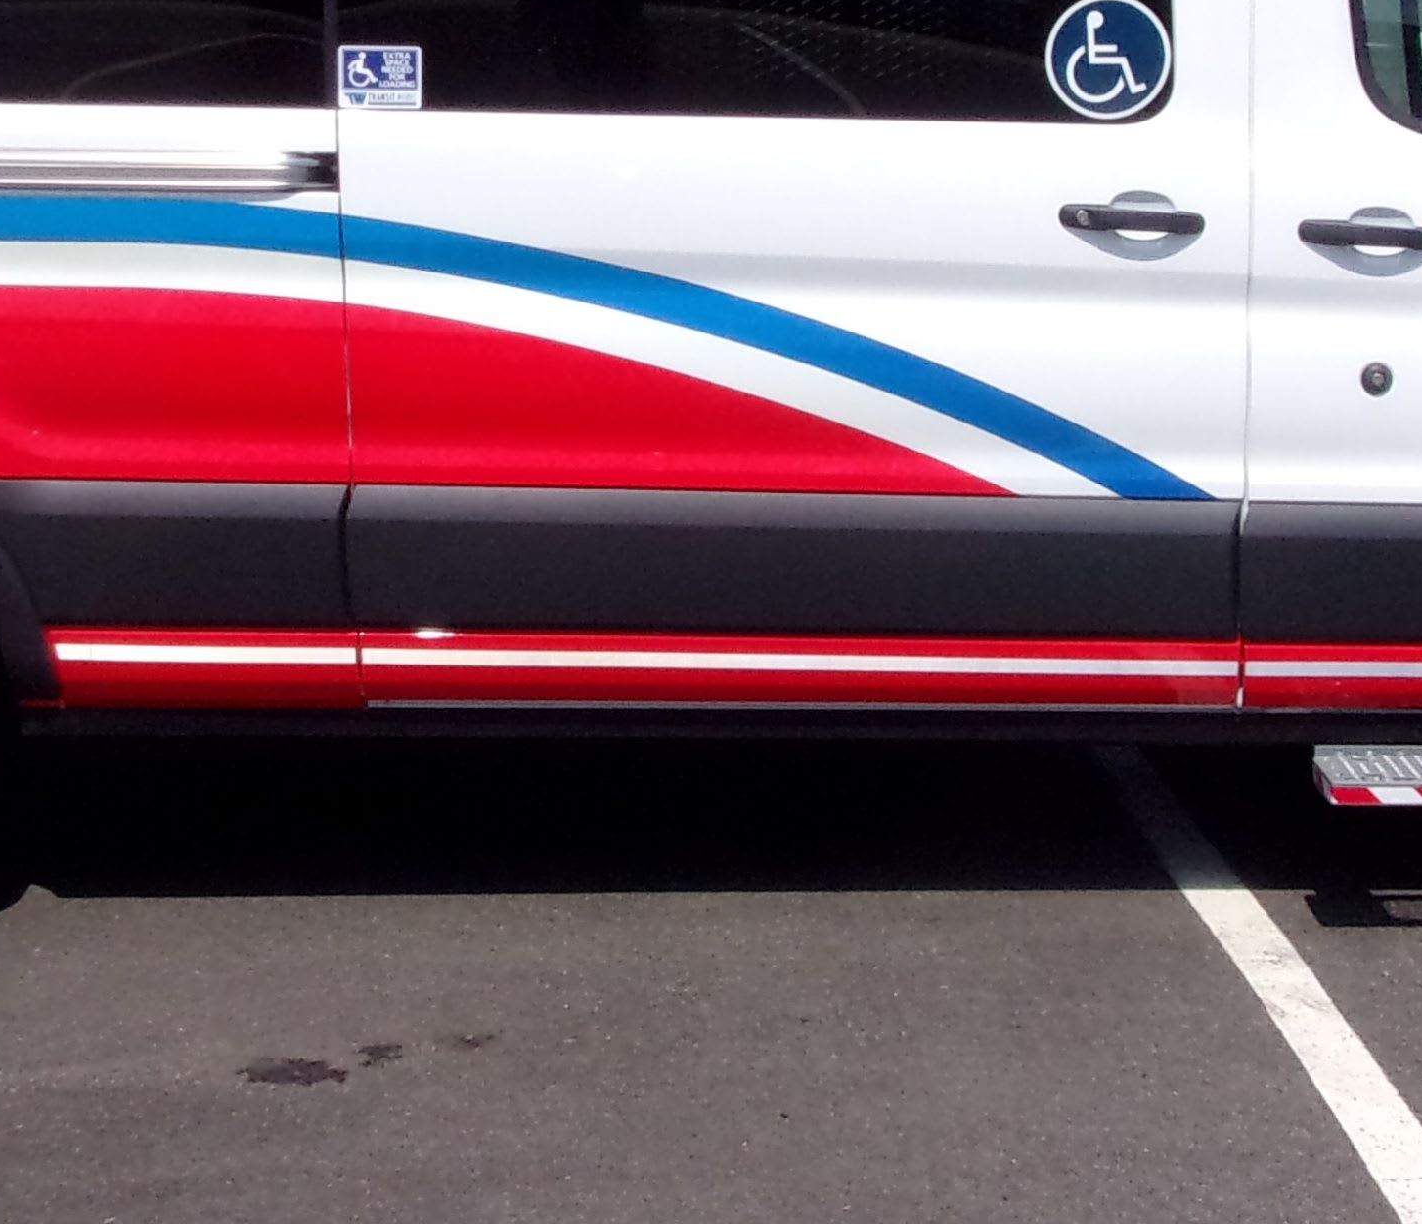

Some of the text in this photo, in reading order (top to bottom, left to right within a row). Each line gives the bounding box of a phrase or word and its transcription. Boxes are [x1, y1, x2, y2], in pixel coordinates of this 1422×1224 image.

[383, 51, 411, 60] EXTRA
[385, 59, 410, 67] SPACE
[388, 73, 406, 81] FOR
[378, 80, 416, 88] LOADING
